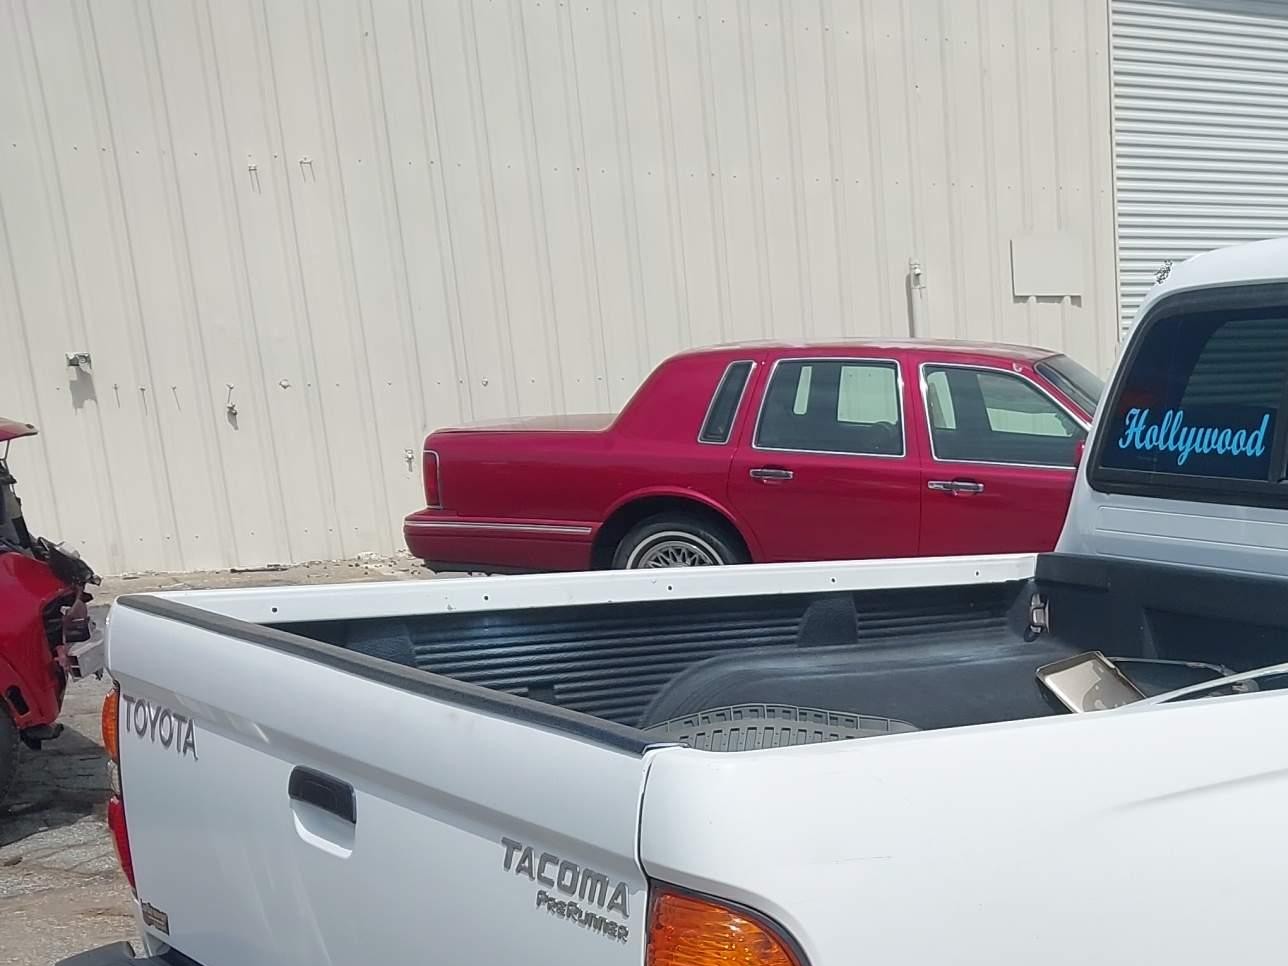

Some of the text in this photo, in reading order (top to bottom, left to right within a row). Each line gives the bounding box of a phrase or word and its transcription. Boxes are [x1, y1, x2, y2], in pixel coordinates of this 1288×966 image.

[1118, 407, 1271, 466] Hollywood
[122, 694, 199, 761] TOYOTA
[501, 836, 630, 919] TACOMA
